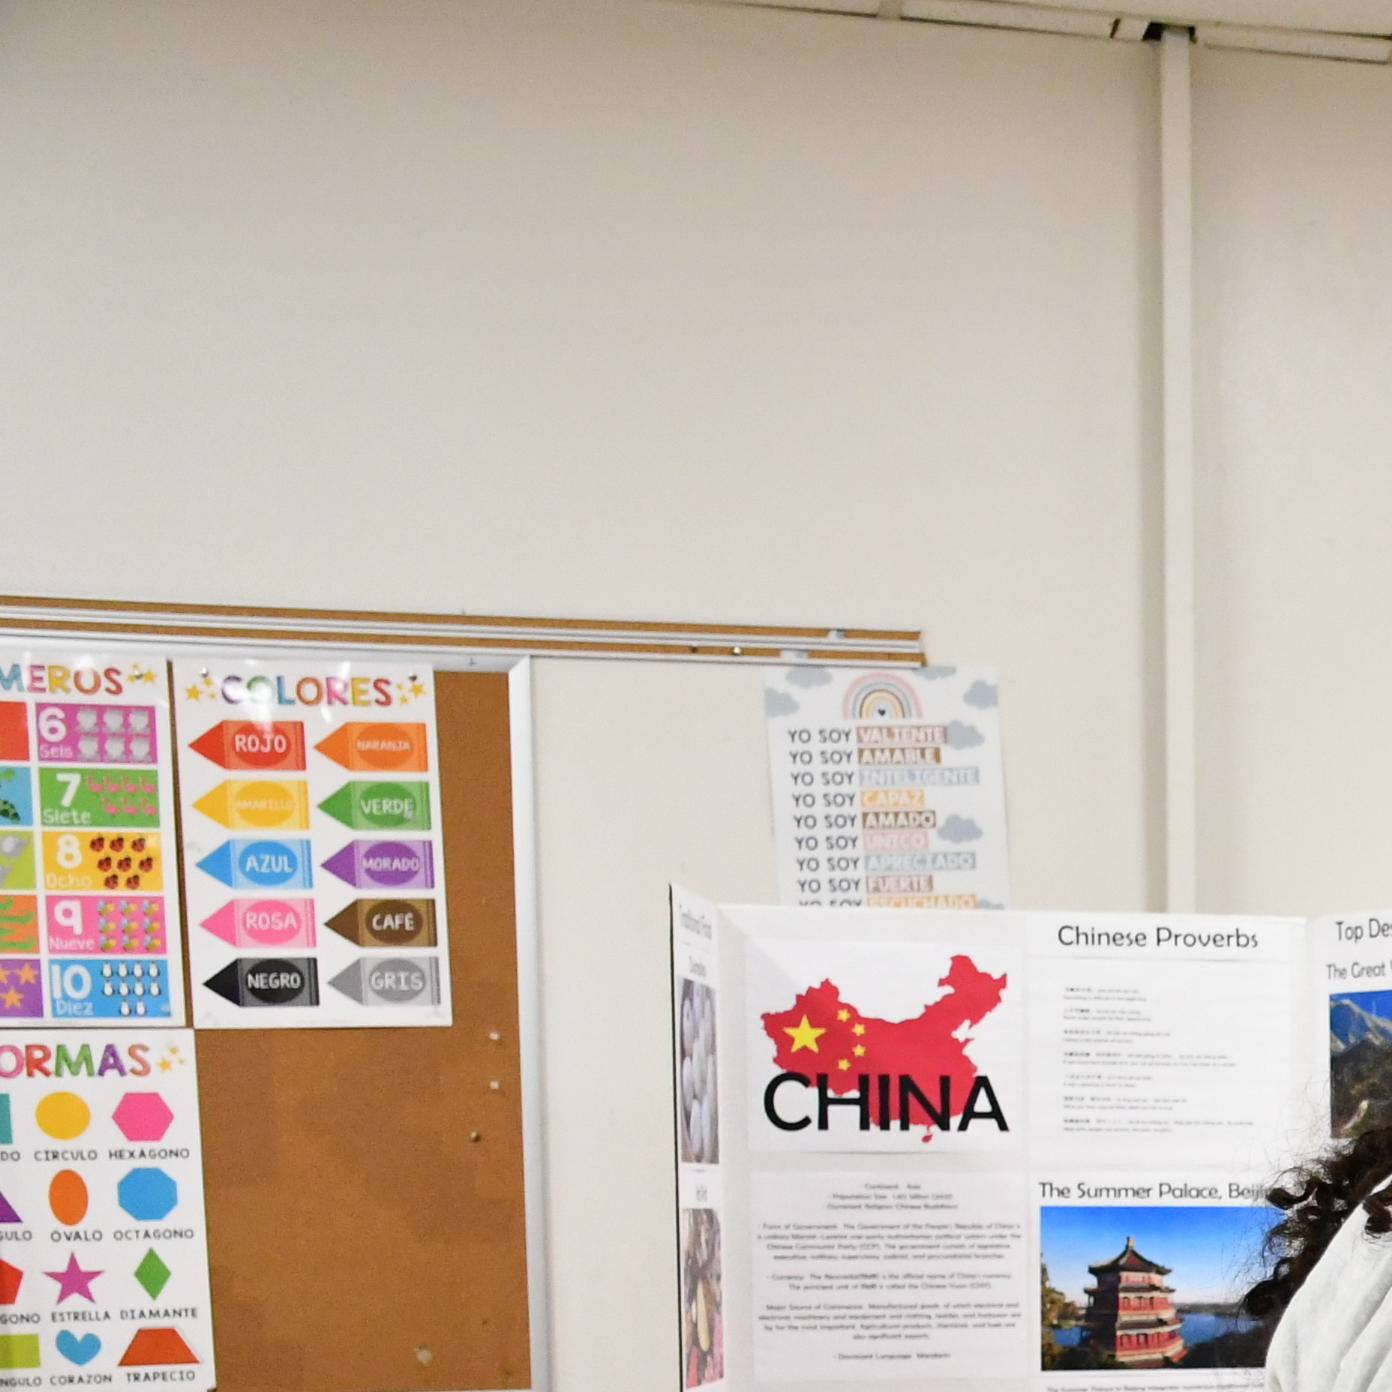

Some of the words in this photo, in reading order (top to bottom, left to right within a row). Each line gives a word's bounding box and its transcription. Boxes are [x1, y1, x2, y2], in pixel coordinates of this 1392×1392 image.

[221, 675, 392, 707] COLORES
[38, 707, 67, 742] 6
[235, 734, 287, 753] ROJO
[788, 729, 811, 744] YO
[819, 729, 852, 744] SOY
[40, 745, 73, 758] Seis
[357, 740, 410, 751] NARANJA
[789, 751, 813, 765] YO
[820, 750, 853, 765] SOY
[791, 772, 814, 786] YO
[821, 772, 854, 786] SOY
[56, 772, 81, 807] 7
[360, 799, 414, 815] VERDE
[792, 793, 816, 807] YO
[823, 793, 855, 807] SOY
[43, 808, 91, 825] Siete
[793, 815, 817, 830] YO
[824, 814, 857, 830] SOY
[865, 811, 935, 829] AMADO
[795, 836, 818, 850] YO
[826, 836, 858, 850] SOY
[57, 834, 82, 869] 8
[245, 854, 293, 873] AZUL
[363, 857, 420, 872] MORADO
[797, 857, 820, 872] YO
[827, 857, 860, 871] SOY
[46, 873, 93, 888] Ocho
[798, 879, 821, 893] YO
[829, 878, 861, 893] SOY
[54, 900, 83, 935] 9
[246, 912, 297, 930] ROSA
[1057, 924, 1147, 947] Chinese
[1155, 927, 1259, 948] Proverbs
[1335, 920, 1364, 943] Top
[49, 937, 95, 950] Nueve
[1326, 963, 1347, 980] The
[1351, 962, 1385, 979] Great
[51, 964, 92, 1000] 10
[247, 973, 300, 989] NEGRO
[371, 971, 423, 991] GRIS
[56, 1000, 94, 1016] Diez
[764, 1071, 1010, 1132] CHINA
[1038, 1181, 1071, 1199] The
[1077, 1182, 1152, 1199] Summer
[1158, 1182, 1222, 1201] Palace,
[51, 1310, 111, 1323] ESTRELLA
[120, 1308, 198, 1320] DIAMANTE
[126, 1370, 196, 1383] TRAPECIO
